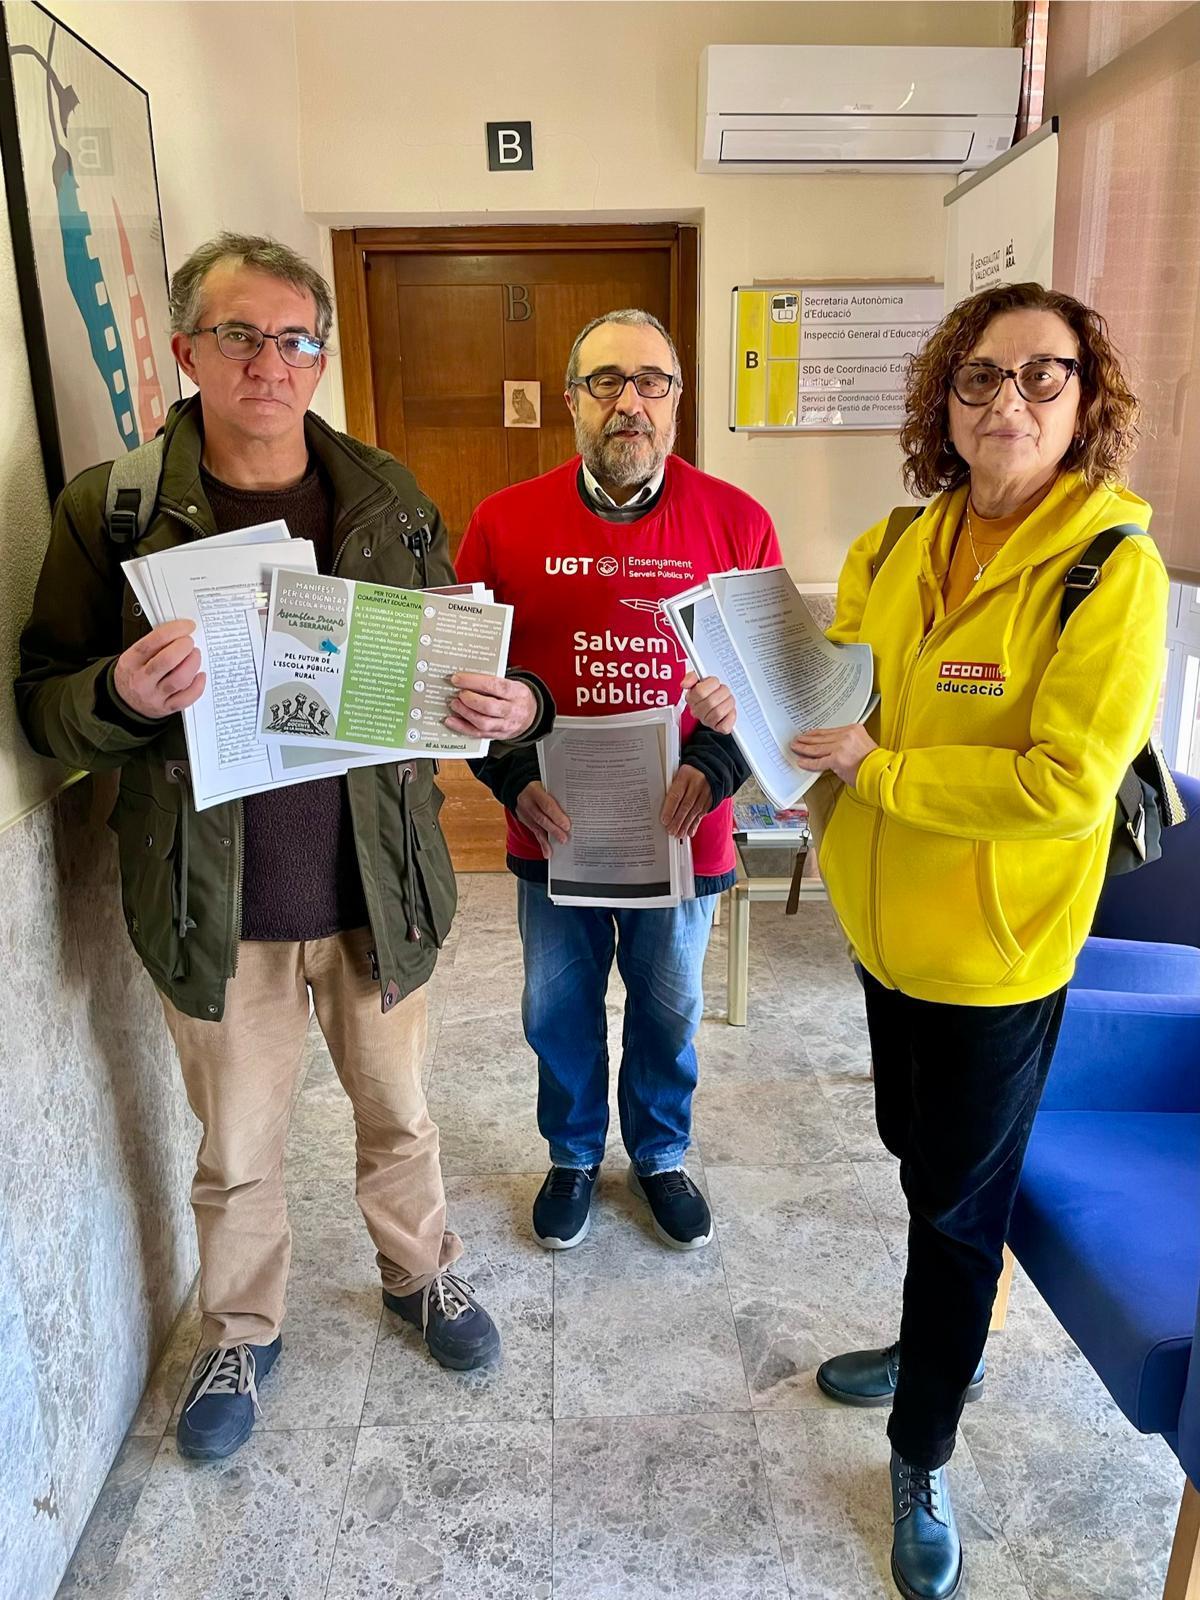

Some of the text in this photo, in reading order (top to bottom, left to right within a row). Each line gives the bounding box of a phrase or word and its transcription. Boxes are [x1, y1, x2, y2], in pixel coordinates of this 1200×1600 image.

[498, 130, 523, 164] B
[503, 282, 533, 321] B
[804, 296, 903, 306] Secretaria Autonòmica
[804, 309, 851, 319] d'Educació
[804, 328, 930, 340] Inspecció General d'Educació
[746, 351, 759, 369] B
[802, 366, 821, 374] SDG
[823, 365, 834, 374] de
[836, 364, 888, 373] Coordinació
[838, 394, 880, 402] Coordinació
[545, 557, 594, 575] UGT
[628, 556, 693, 570] Ensenyament
[629, 570, 694, 580] Serveis Públics PV
[296, 581, 334, 593] MANIFEST
[283, 589, 346, 604] PER LA DIGNITAT
[357, 594, 421, 609] COMUNITAT EDUCATIVA
[448, 603, 483, 615] DEMANEM
[573, 630, 668, 654] Salvem
[298, 654, 319, 662] FUTUR
[306, 663, 334, 673] PÚBLICA
[575, 655, 672, 680] l'escola
[941, 664, 984, 678] CCOO
[576, 681, 668, 707] pública
[936, 680, 1004, 697] educació
